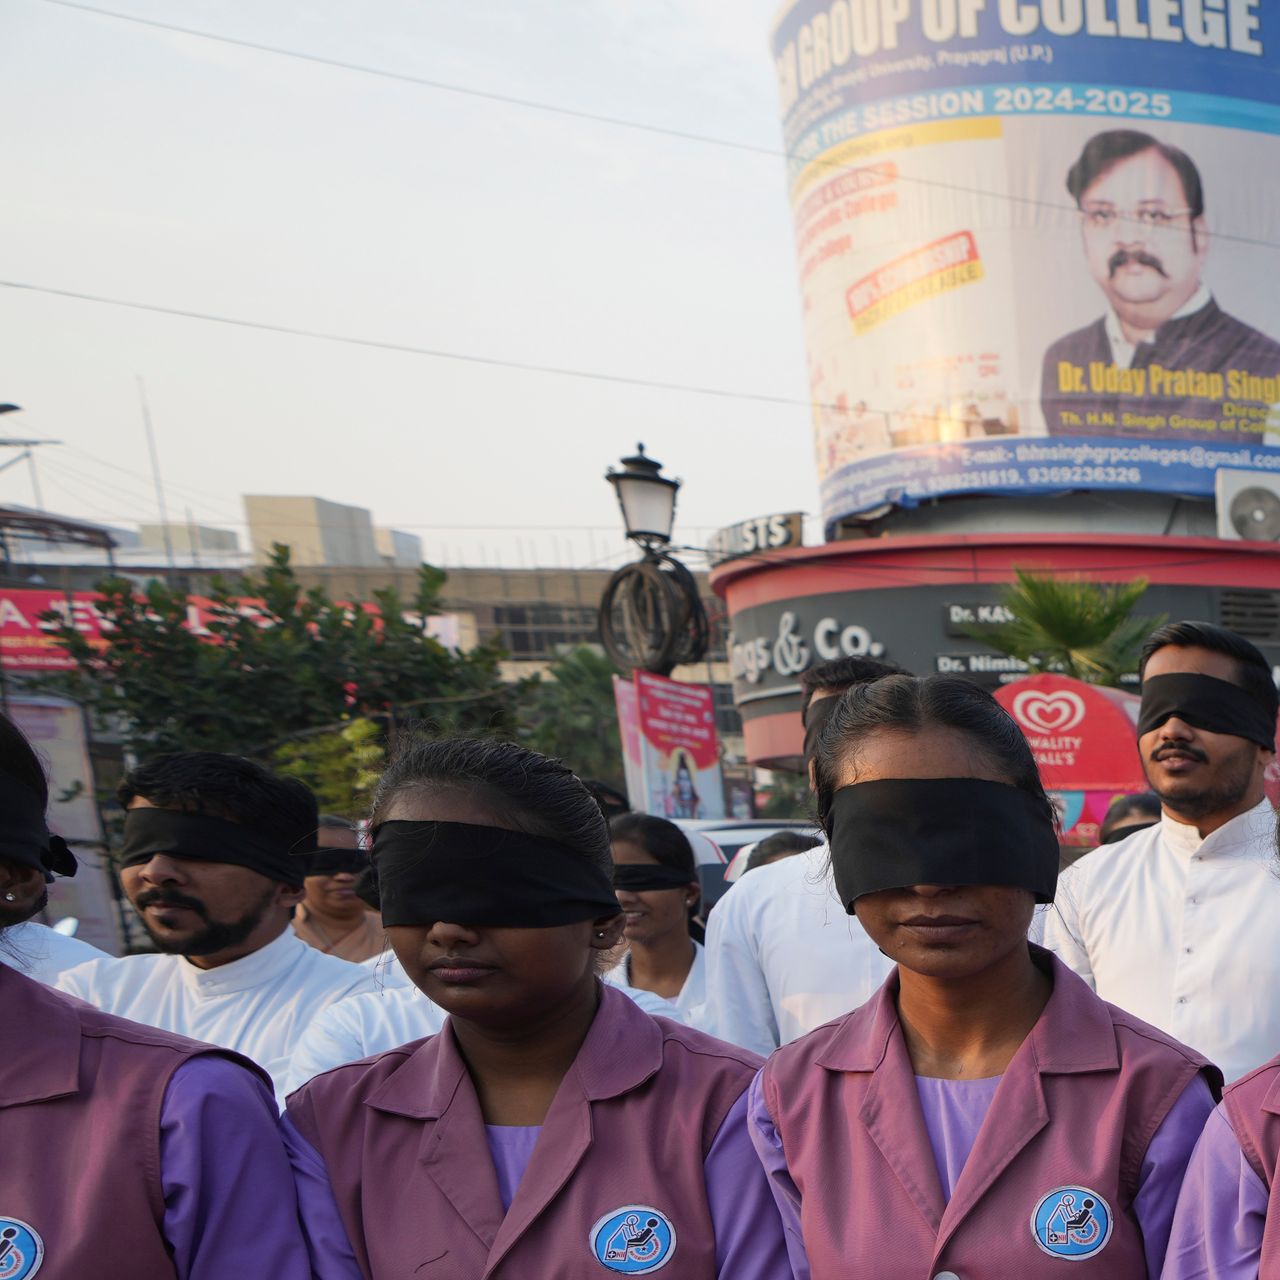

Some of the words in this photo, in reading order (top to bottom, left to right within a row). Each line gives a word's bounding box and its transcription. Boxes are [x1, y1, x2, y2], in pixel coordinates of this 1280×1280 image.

[798, 0, 912, 89] GROUP
[1000, 0, 1264, 56] COLLEGE
[863, 90, 985, 130] SESSION
[994, 88, 1172, 117] 2024-2025
[1058, 361, 1088, 394] Dr.
[1090, 362, 1146, 396] Uday
[1149, 364, 1224, 400] Pratap
[1122, 413, 1166, 431] Singh
[1169, 415, 1217, 433] Group
[1220, 417, 1236, 431] of
[950, 604, 975, 624] Dr.
[774, 611, 811, 676] &
[814, 617, 884, 661] Co.
[937, 656, 966, 673] Dr.
[1028, 736, 1083, 750] WALITY
